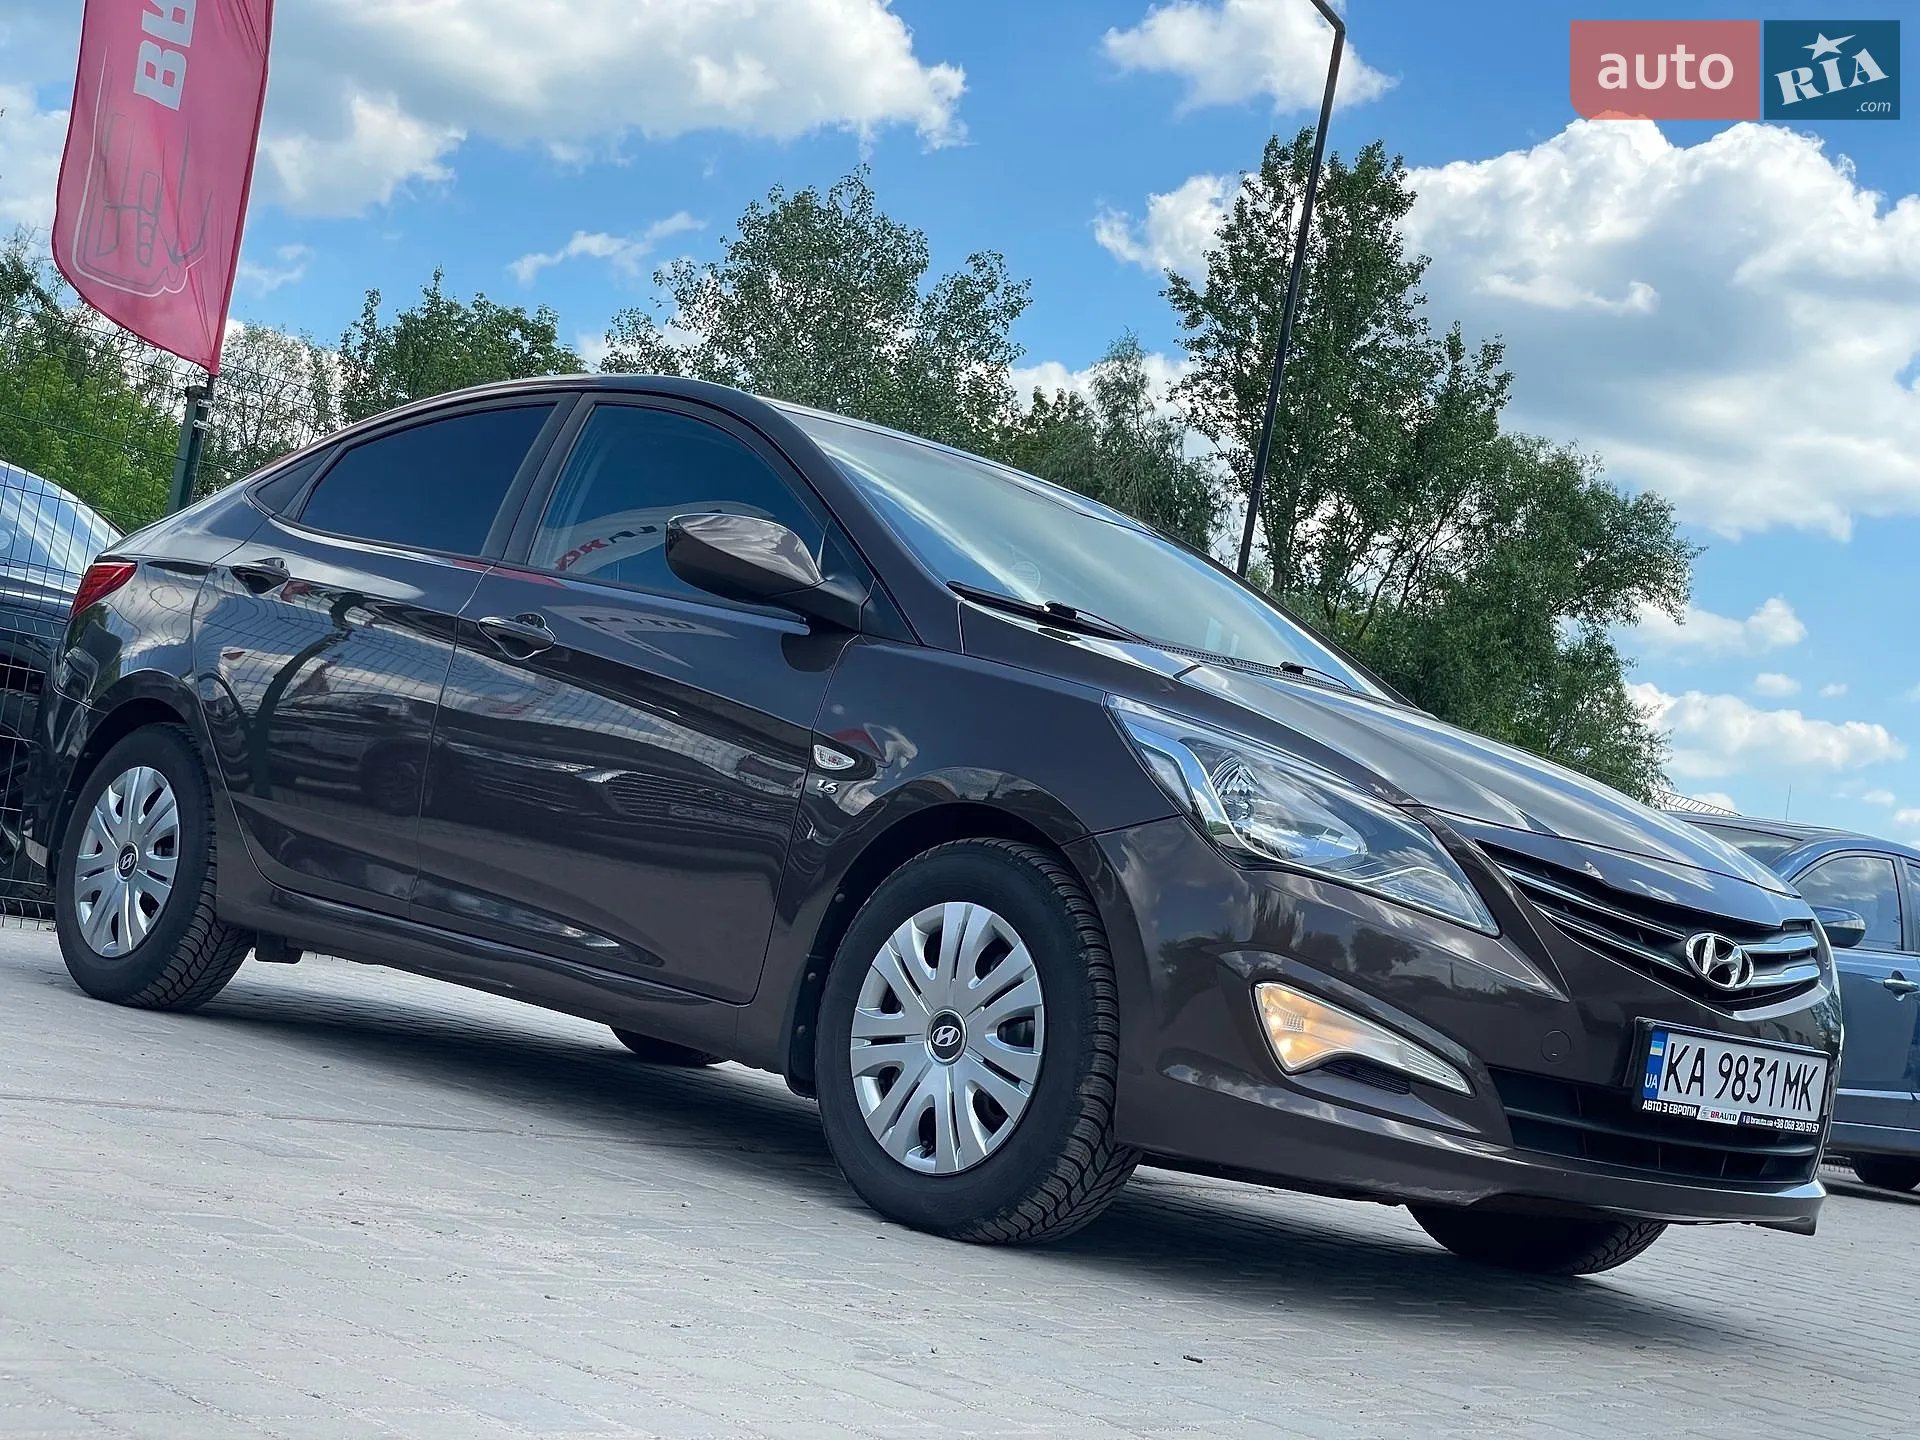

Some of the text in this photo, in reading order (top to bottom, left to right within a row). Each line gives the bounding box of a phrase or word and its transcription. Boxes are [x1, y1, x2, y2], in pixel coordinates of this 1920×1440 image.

[1644, 1072, 1658, 1089] UA
[1663, 1042, 1819, 1112] KA 9831 MK
[1642, 1100, 1662, 1112] АВТО
[1710, 1111, 1737, 1122] BRAUTO
